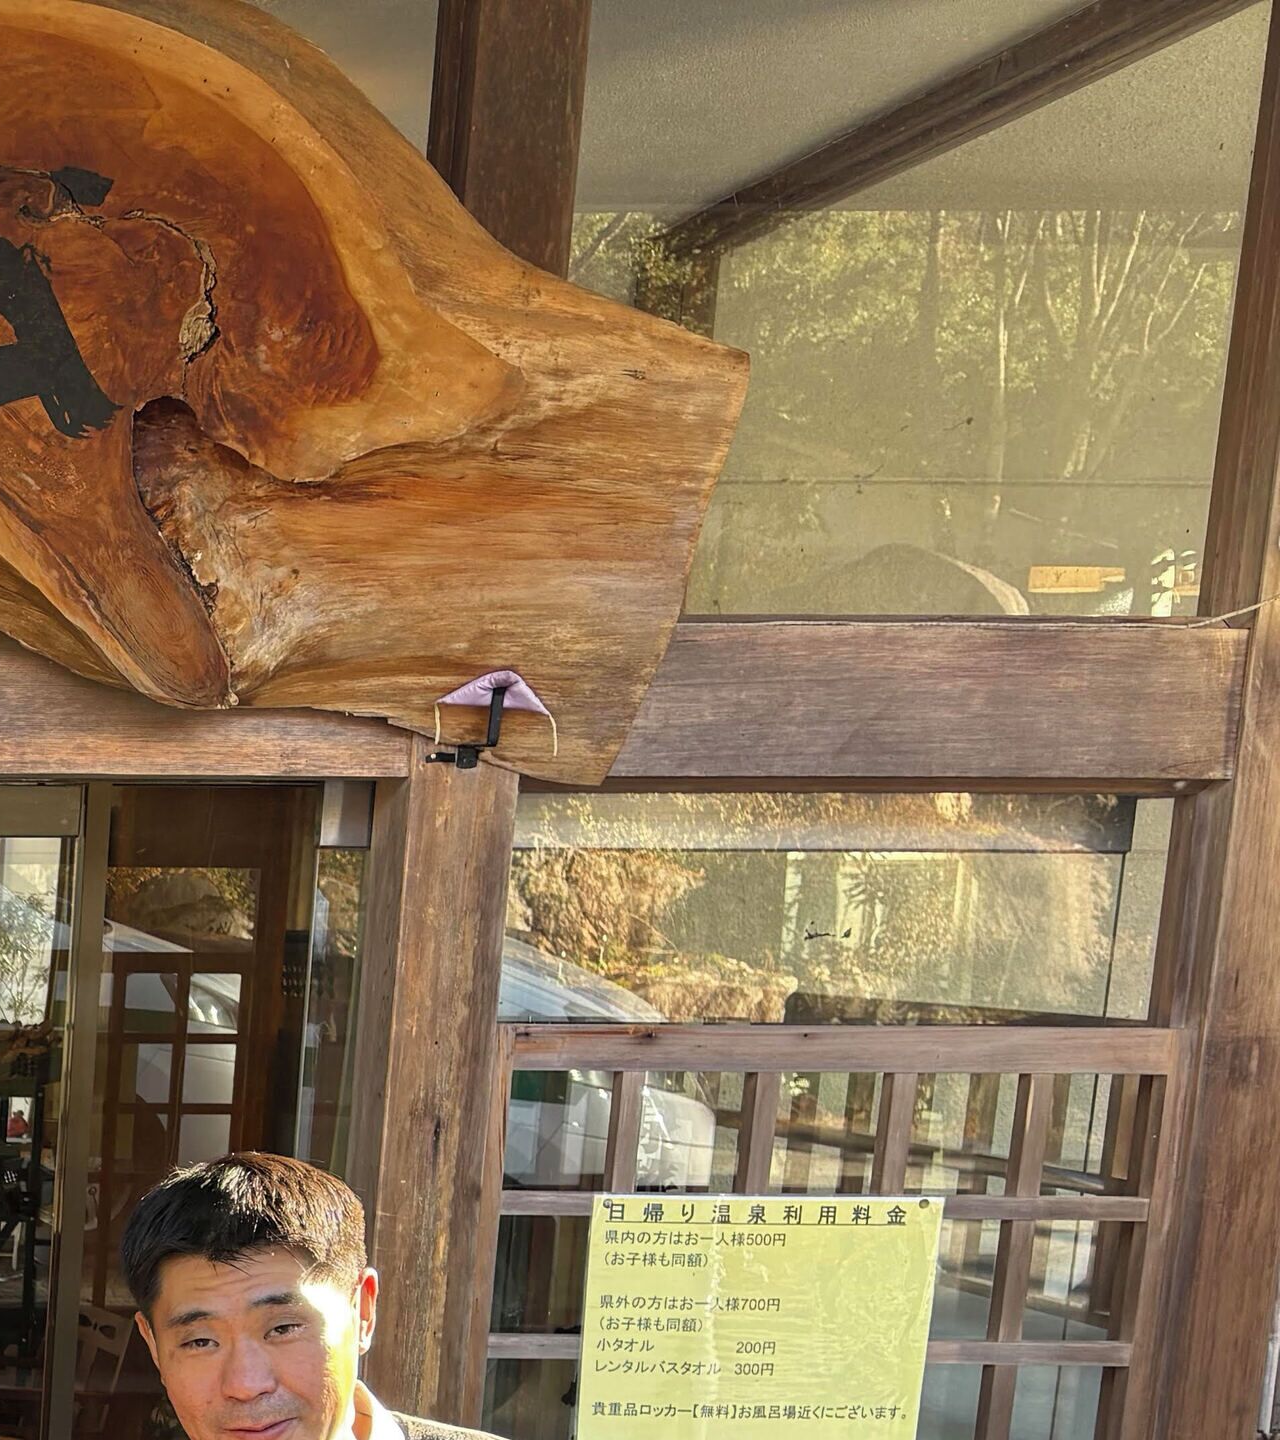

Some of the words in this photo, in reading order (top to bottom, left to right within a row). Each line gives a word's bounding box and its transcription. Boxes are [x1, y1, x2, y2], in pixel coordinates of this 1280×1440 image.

[607, 1203, 908, 1225] 日帰り温泉利用料金
[604, 1229, 787, 1248] 県内の方はお一人様500円
[599, 1294, 782, 1312] 県外の方はお一人様700円
[596, 1337, 655, 1353] 小タオル
[735, 1340, 777, 1355] 200円
[594, 1359, 722, 1377] レンタルバスタオル
[733, 1362, 775, 1377] 300円
